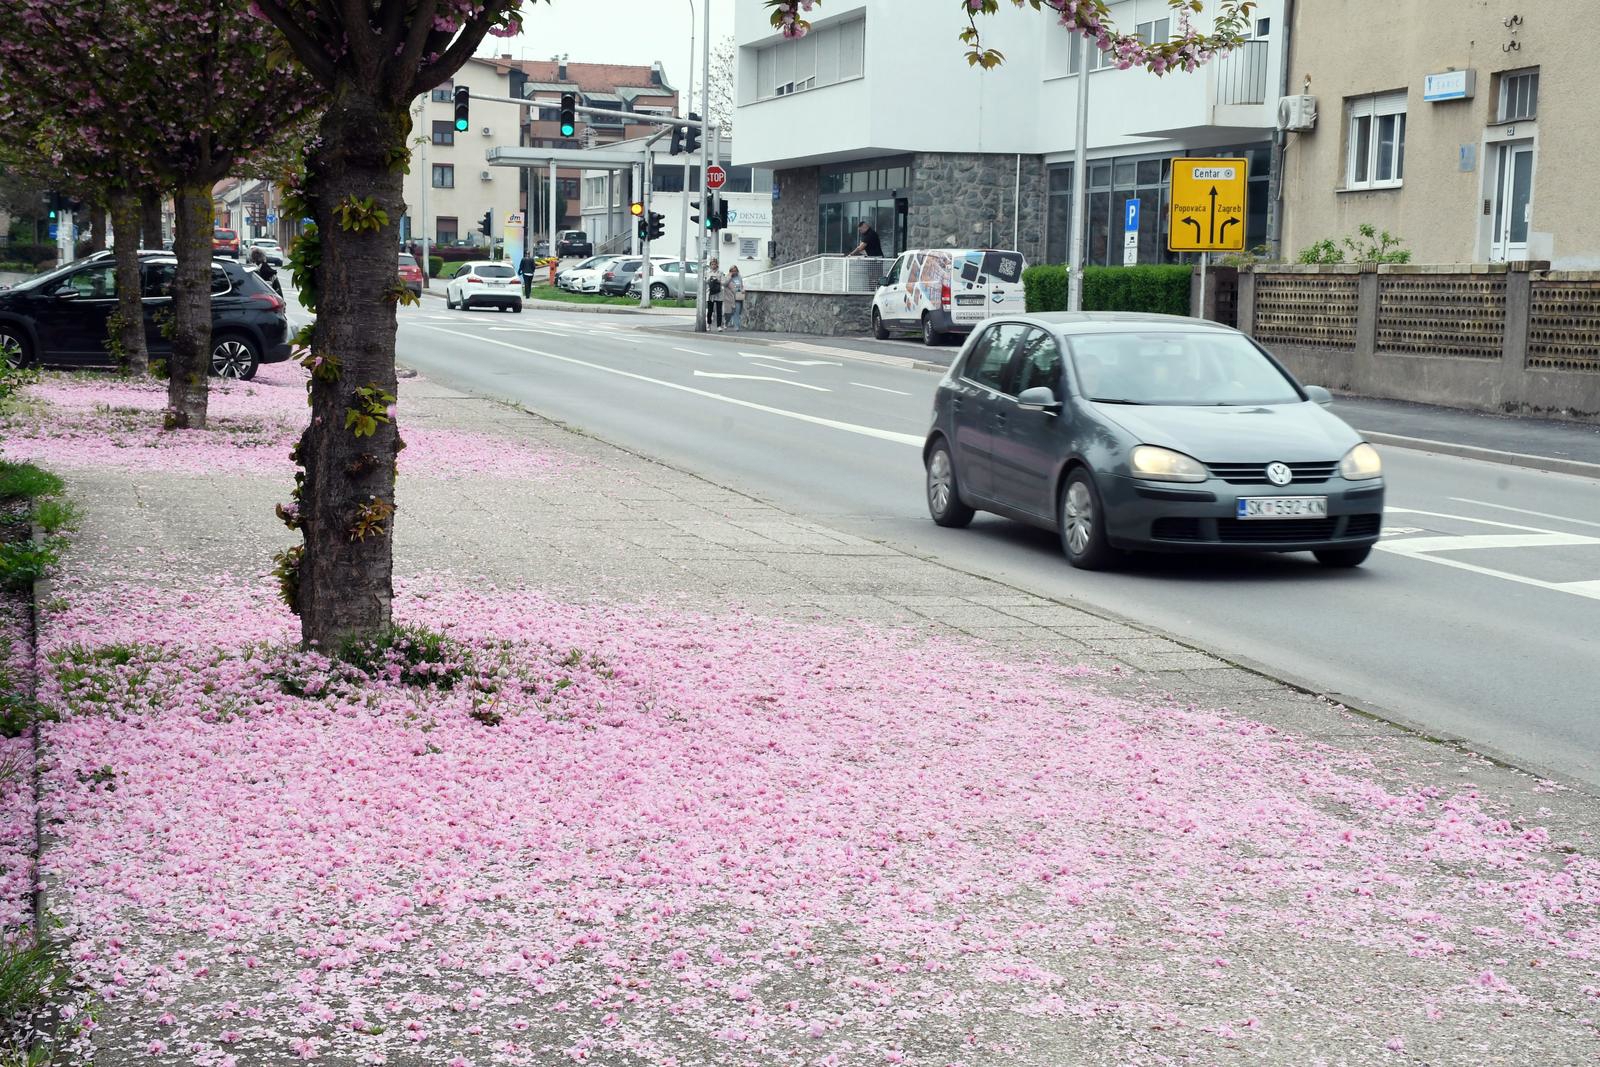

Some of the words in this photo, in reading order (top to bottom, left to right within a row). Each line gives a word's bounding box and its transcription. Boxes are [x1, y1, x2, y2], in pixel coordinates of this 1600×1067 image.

[1194, 168, 1220, 178] Centar
[1217, 203, 1242, 214] Zagreb
[739, 212, 767, 220] DENTAL
[1128, 204, 1136, 226] P
